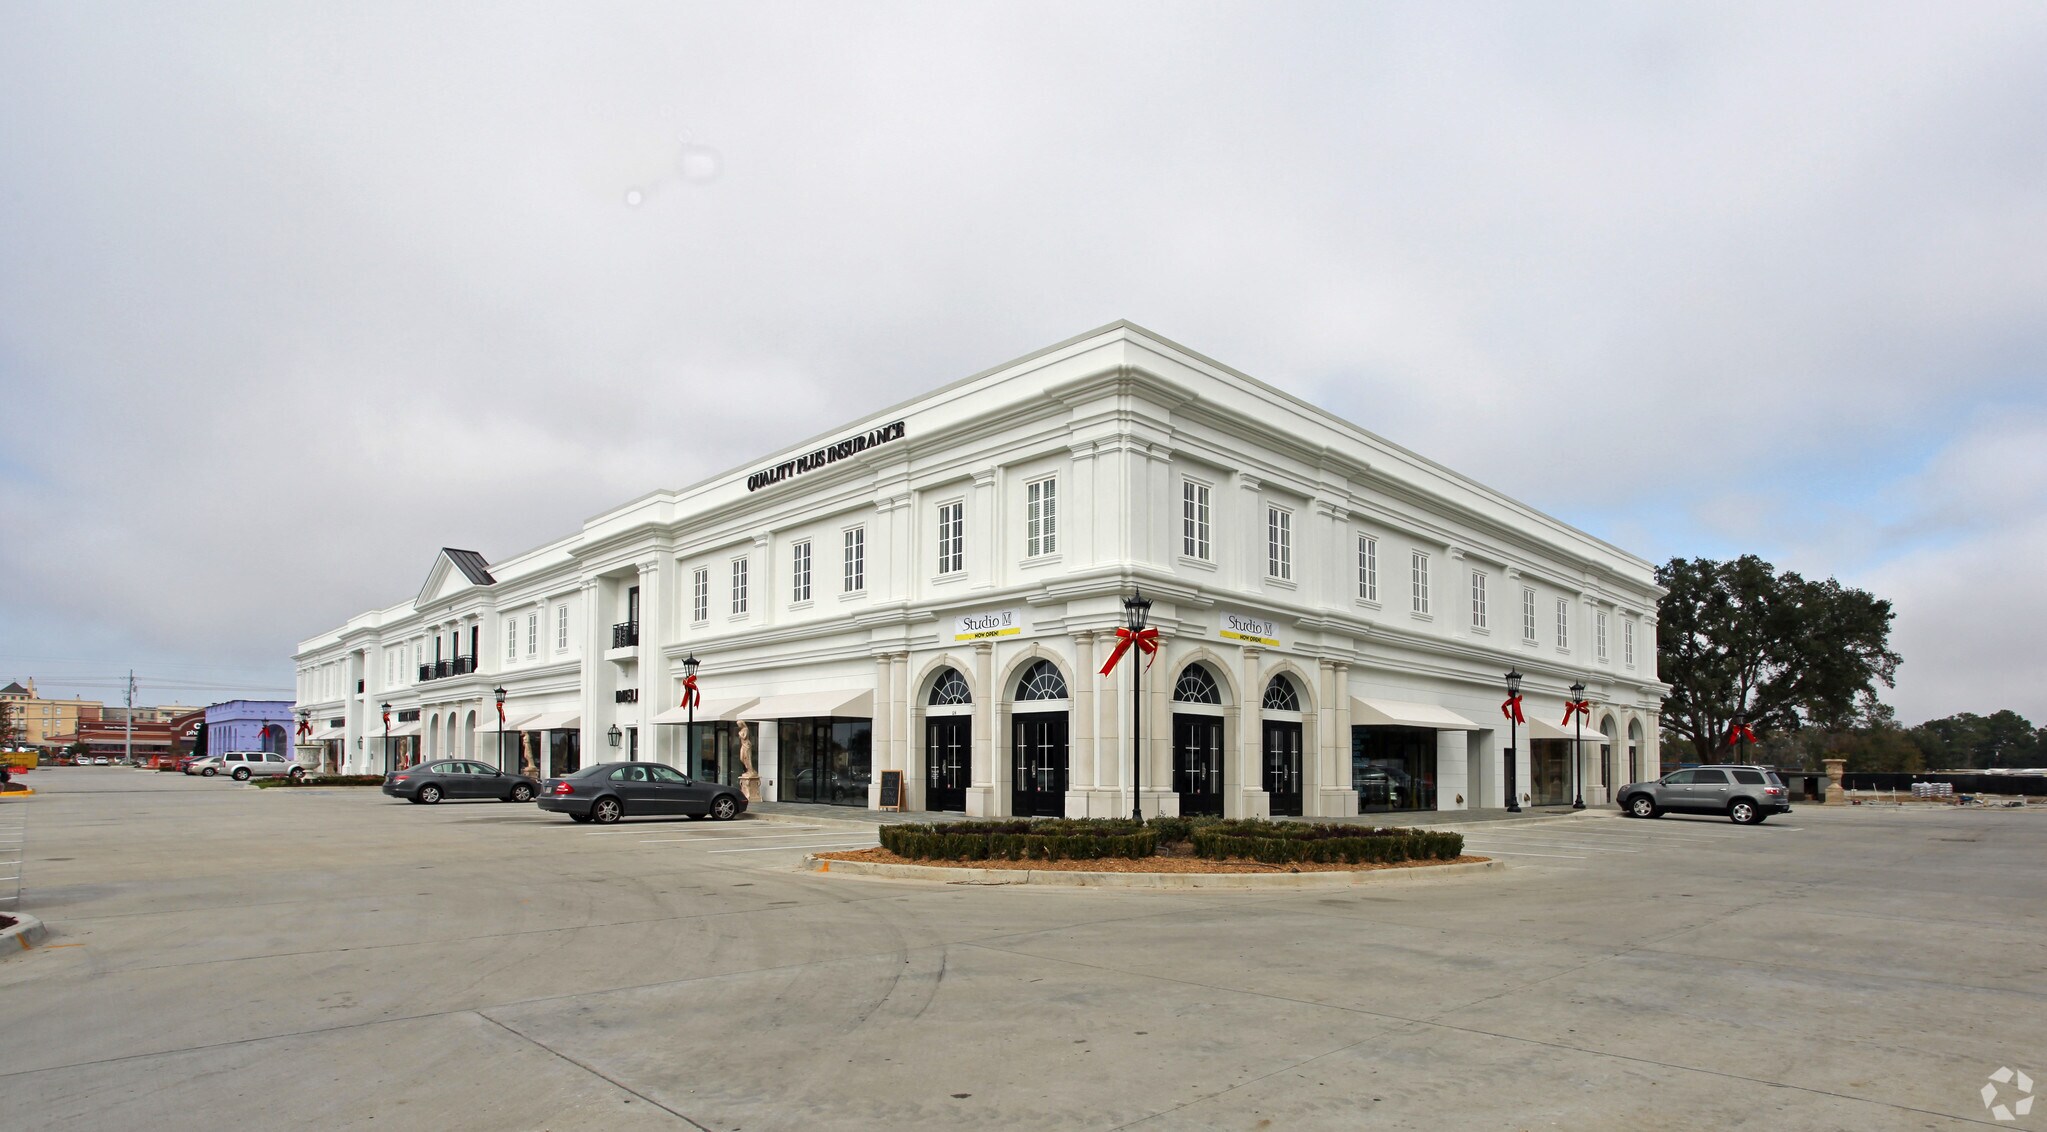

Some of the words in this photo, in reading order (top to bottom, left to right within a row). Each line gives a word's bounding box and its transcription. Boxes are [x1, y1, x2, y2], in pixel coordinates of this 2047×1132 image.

[747, 461, 795, 492] QUALITY
[796, 449, 826, 475] PLUS
[826, 421, 905, 464] INSURANCE
[963, 615, 1000, 631] Studio
[1228, 615, 1262, 634] Studio
